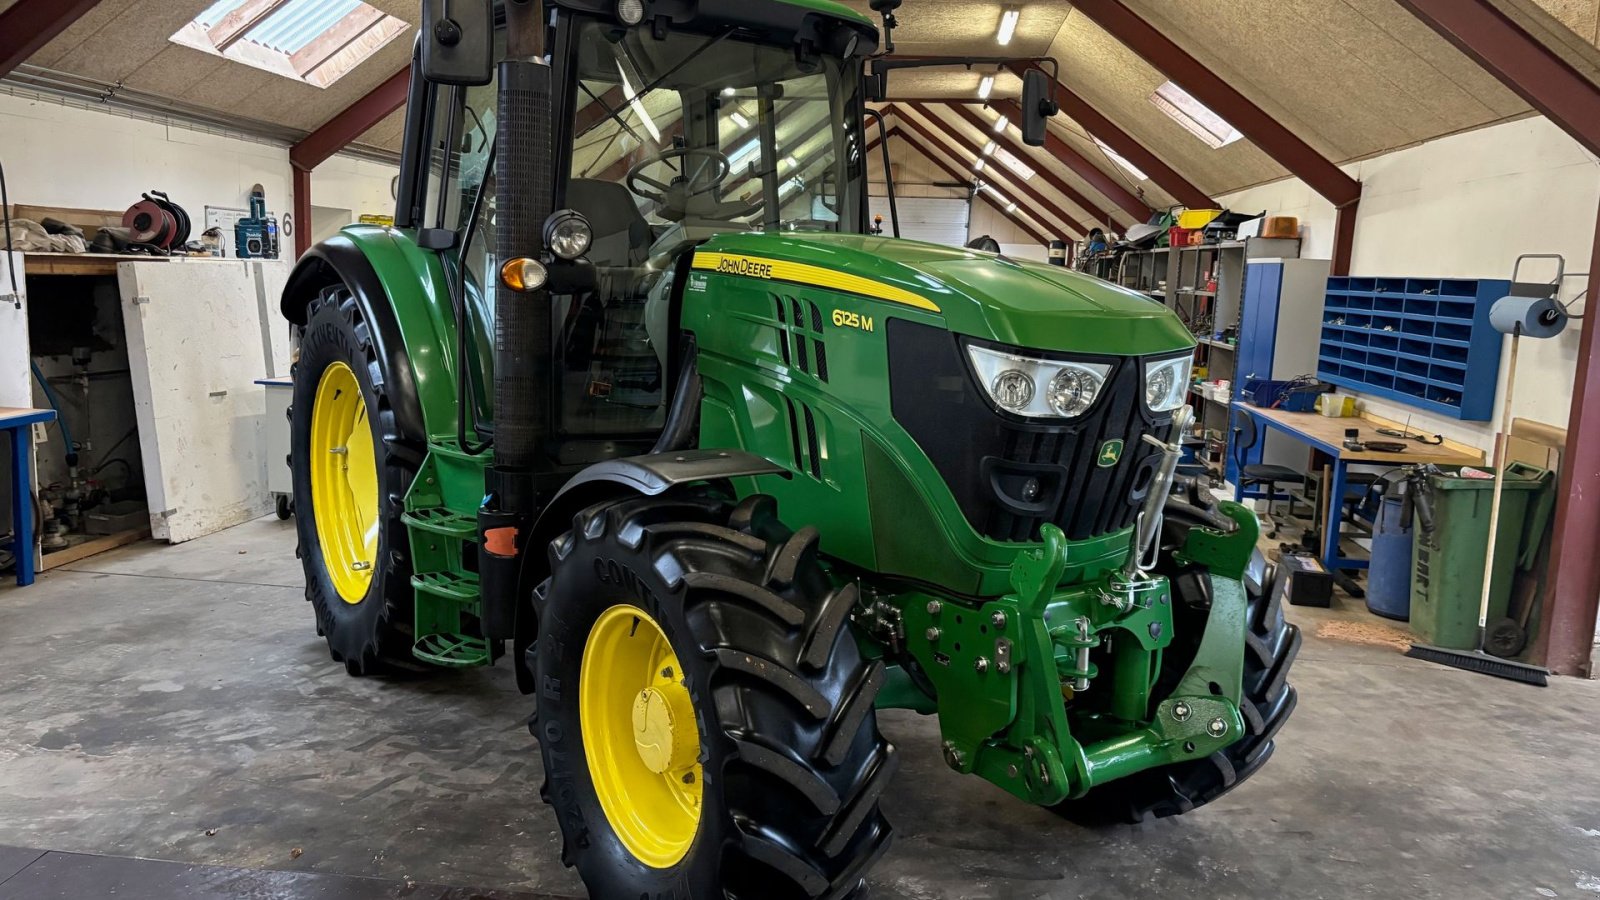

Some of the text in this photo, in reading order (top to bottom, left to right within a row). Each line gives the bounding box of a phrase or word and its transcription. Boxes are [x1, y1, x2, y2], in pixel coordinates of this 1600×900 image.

[282, 212, 293, 238] 6
[716, 256, 773, 278] JOHN DEERE
[832, 309, 873, 332] 6125 M
